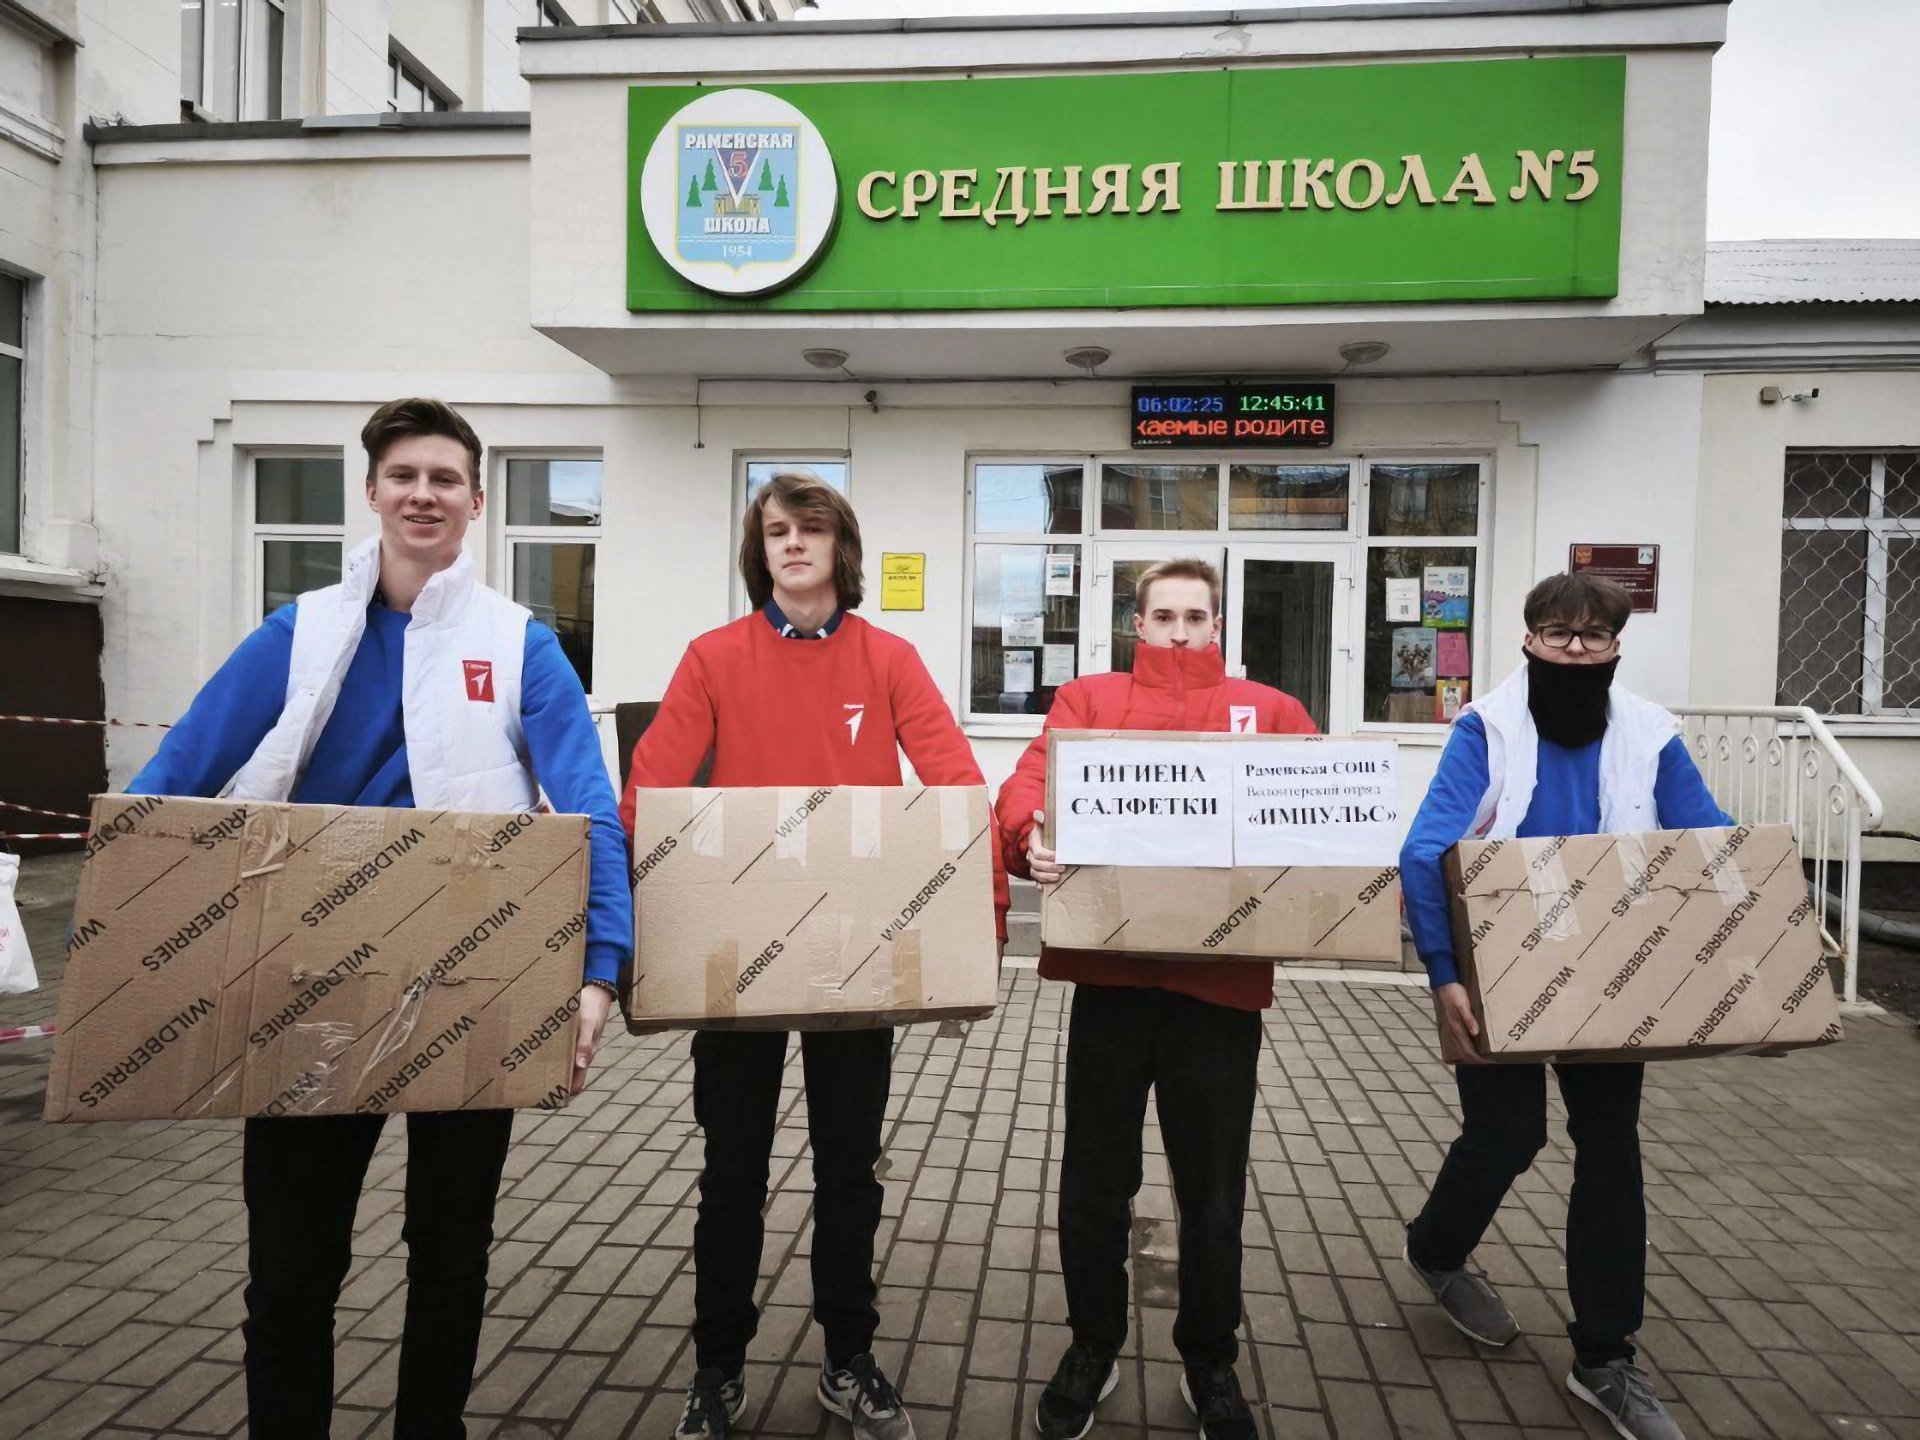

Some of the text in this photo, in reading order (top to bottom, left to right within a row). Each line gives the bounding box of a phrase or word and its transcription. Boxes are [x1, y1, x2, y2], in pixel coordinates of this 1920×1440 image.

[729, 151, 748, 178] 5
[857, 161, 1182, 227] СРЕДНЯЯ
[1215, 152, 1497, 211] ШКОЛА
[704, 218, 771, 234] ШКОЛА
[723, 245, 753, 257] 1954
[1137, 395, 1326, 413] 06:02:25 12:45:41
[1083, 763, 1207, 784] ГИГИЕНА
[1381, 760, 1391, 773] 5
[1071, 796, 1218, 816] САЛФЕТКИ
[1248, 805, 1397, 825] «ИМПУЛЬС»
[300, 827, 426, 928] WILDBERRIES
[880, 862, 957, 943] WILDBERRIES
[1611, 844, 1676, 918] WILDBERRIES
[1520, 878, 1587, 952] WILDBERRIES
[1695, 889, 1762, 966] WILDBERRIES
[249, 941, 379, 1050] WILDBERRIES
[1602, 924, 1670, 1000] WILDBERRIES
[1508, 965, 1576, 1041] WILDBERRIES
[1687, 973, 1756, 1047] WILDBERRIES
[79, 997, 216, 1108] WILDBERRIES
